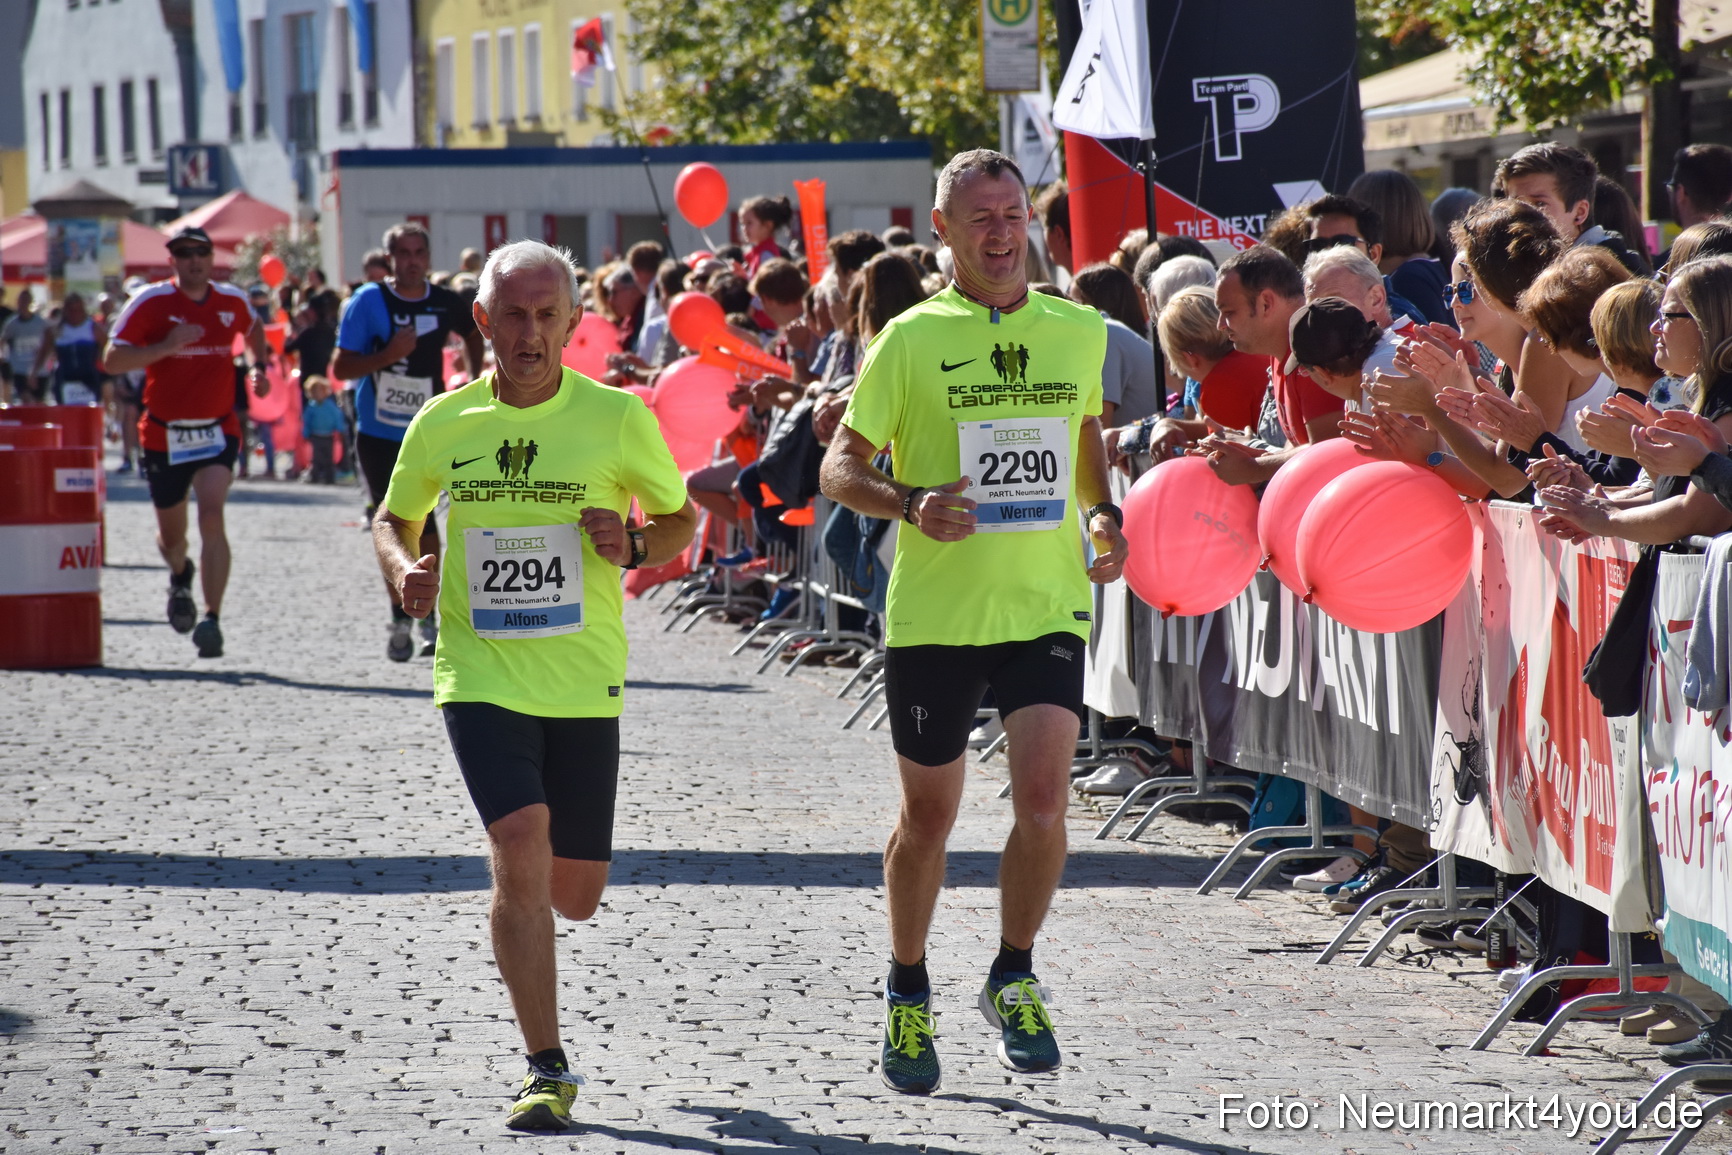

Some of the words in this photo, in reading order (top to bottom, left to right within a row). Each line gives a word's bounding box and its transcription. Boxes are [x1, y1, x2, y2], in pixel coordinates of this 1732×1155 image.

[1174, 219, 1213, 238] THE
[1217, 214, 1267, 235] NEXT
[948, 386, 968, 394] SC
[385, 388, 426, 407] 2500
[948, 392, 1078, 409] LAUFTREFF
[994, 428, 1041, 442] BOCK
[979, 450, 1058, 486] 2290
[451, 480, 467, 489] SC
[450, 490, 585, 504] LAUFTREFF
[1015, 489, 1047, 497] Neumarkt
[1000, 505, 1047, 520] Werner
[495, 537, 546, 550] BOCK
[482, 556, 566, 592] 2294
[504, 613, 548, 627] Alfons
